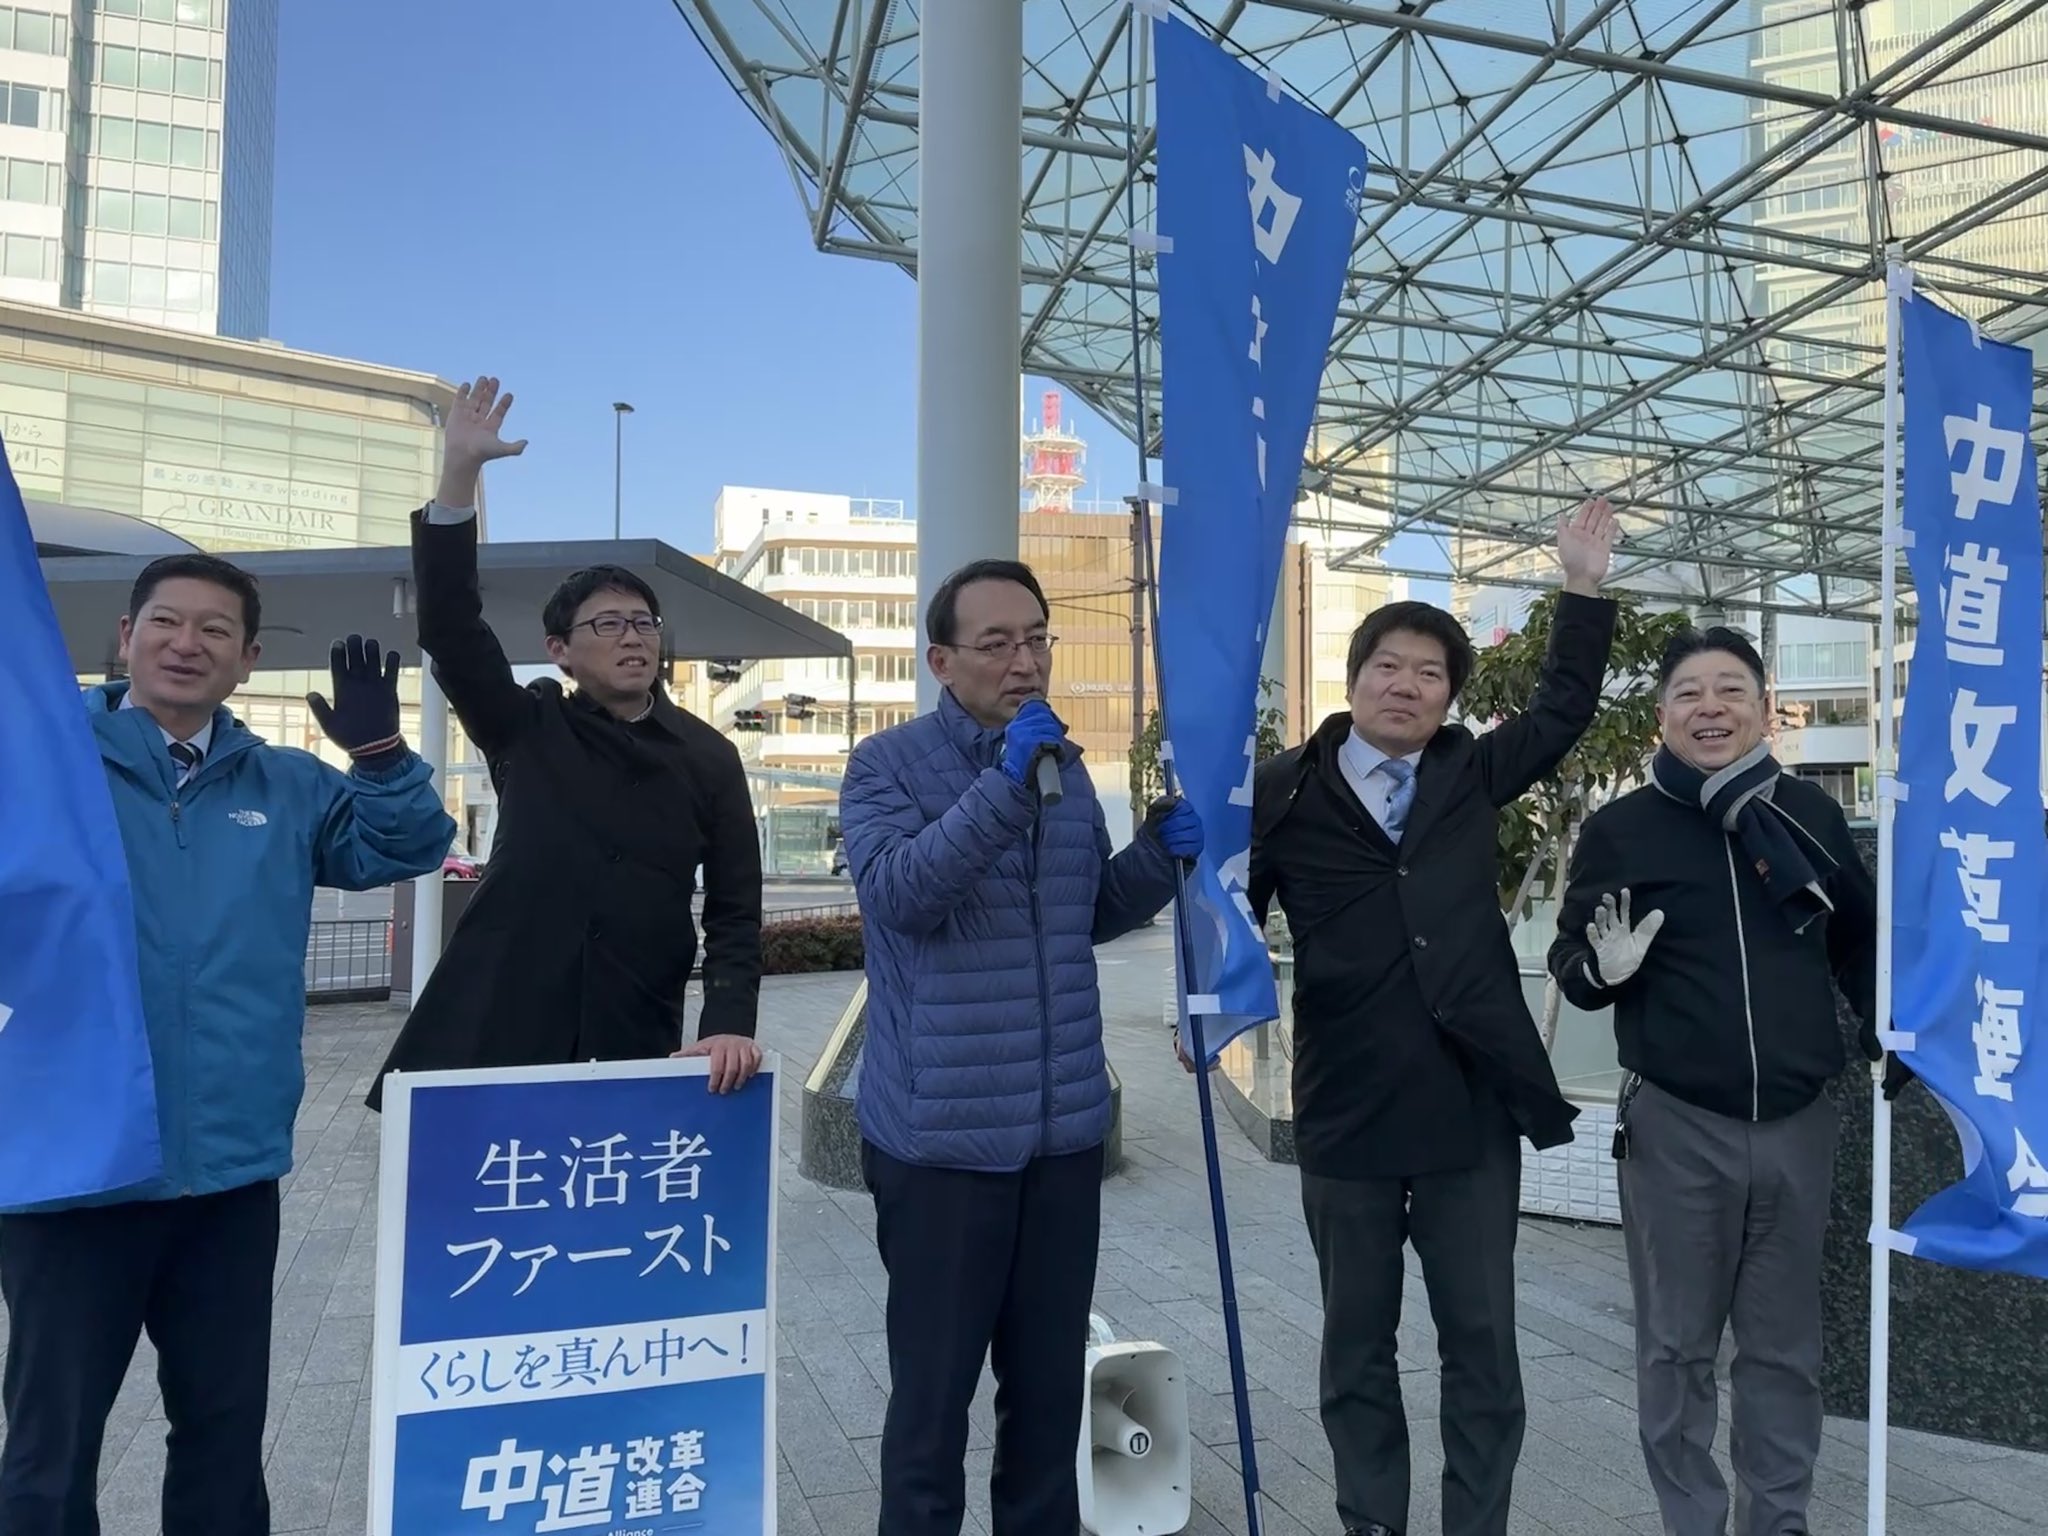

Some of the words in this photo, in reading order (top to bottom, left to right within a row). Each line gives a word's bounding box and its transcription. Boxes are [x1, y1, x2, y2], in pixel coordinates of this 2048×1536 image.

[198, 498, 335, 532] GRANDAIR
[473, 1128, 713, 1214] 生活者
[445, 1213, 732, 1299] ファースト
[419, 1322, 750, 1400] くらしを真ん中へ！
[460, 1437, 620, 1534] 中道
[625, 1428, 706, 1476] 改革
[625, 1472, 707, 1520] 連合
